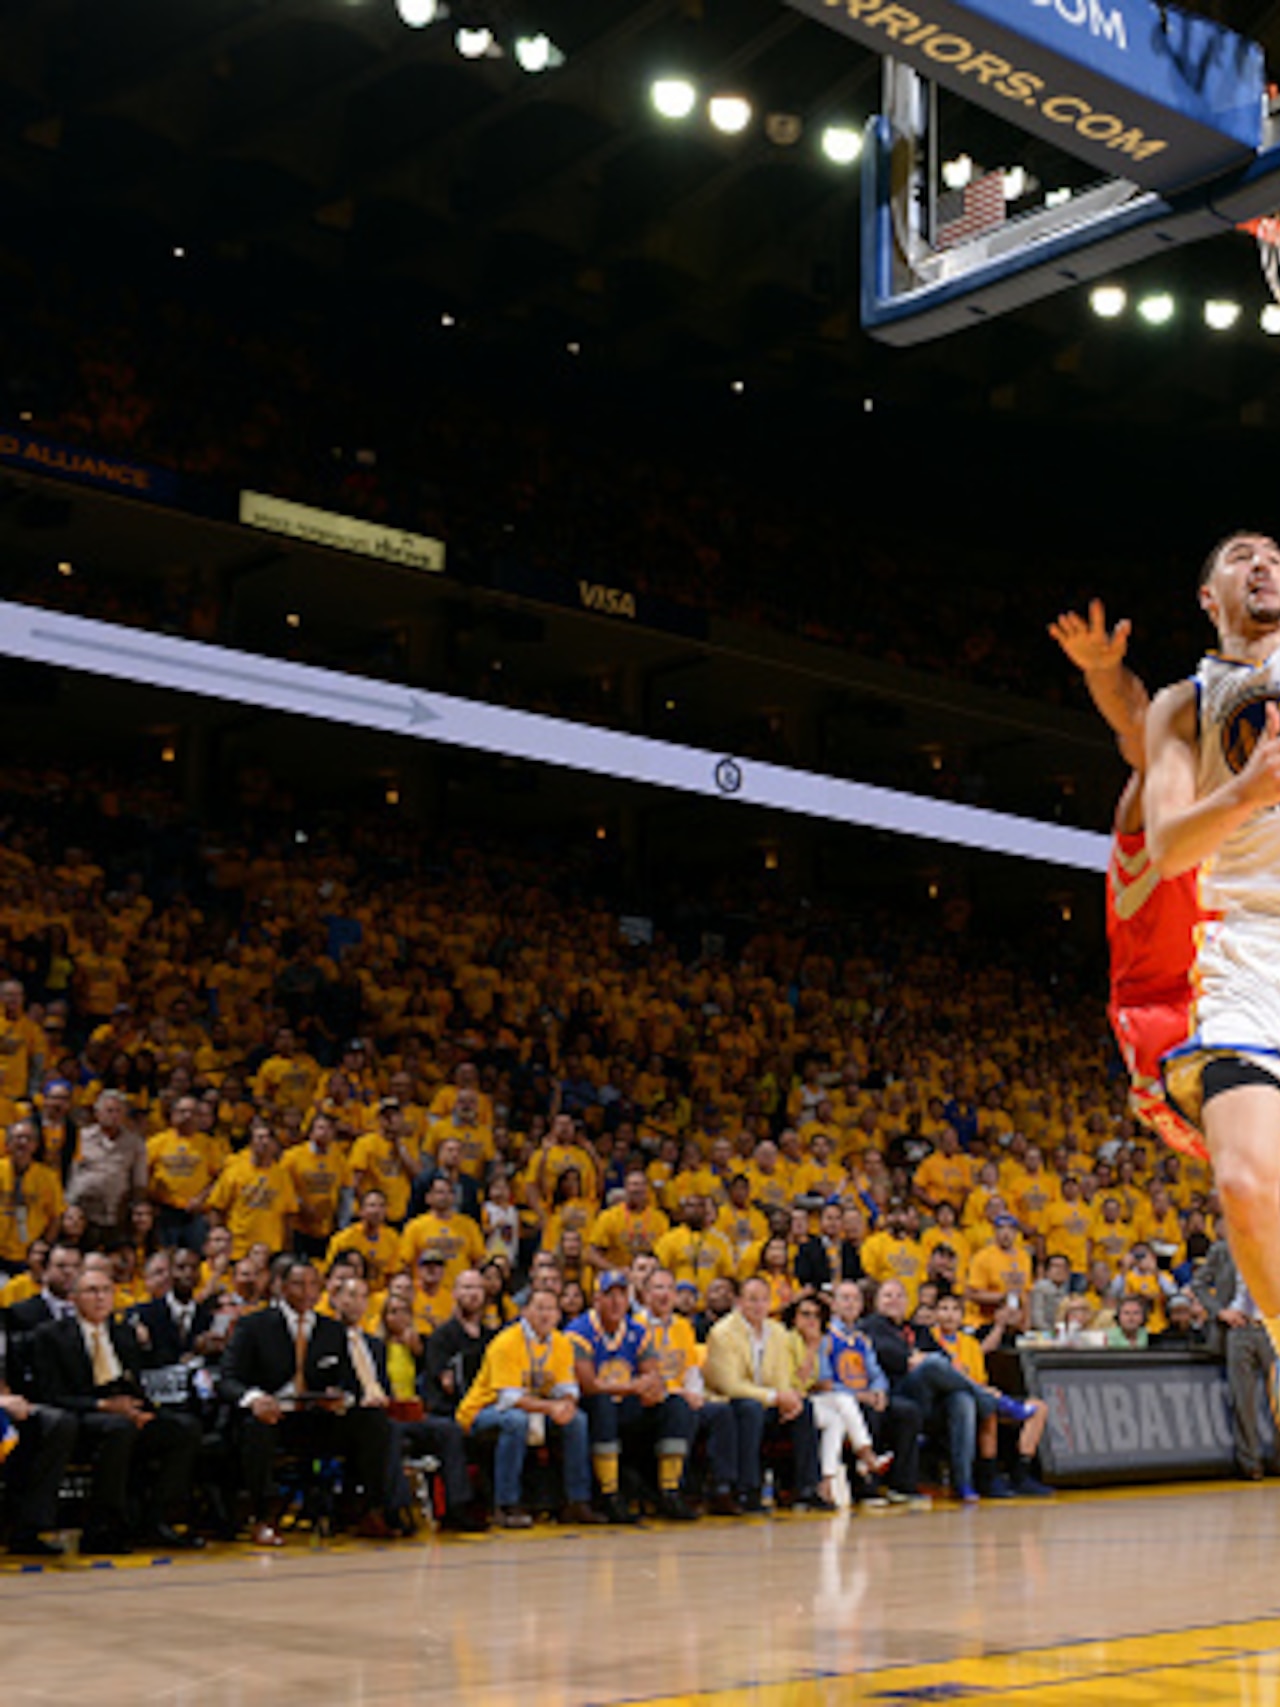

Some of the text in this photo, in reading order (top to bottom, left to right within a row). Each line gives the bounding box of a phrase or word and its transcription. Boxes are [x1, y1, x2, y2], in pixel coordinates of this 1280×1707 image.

[824, 0, 1169, 160] RRIORS.COM
[22, 442, 152, 490] ALLIANCE
[577, 578, 637, 619] VISA
